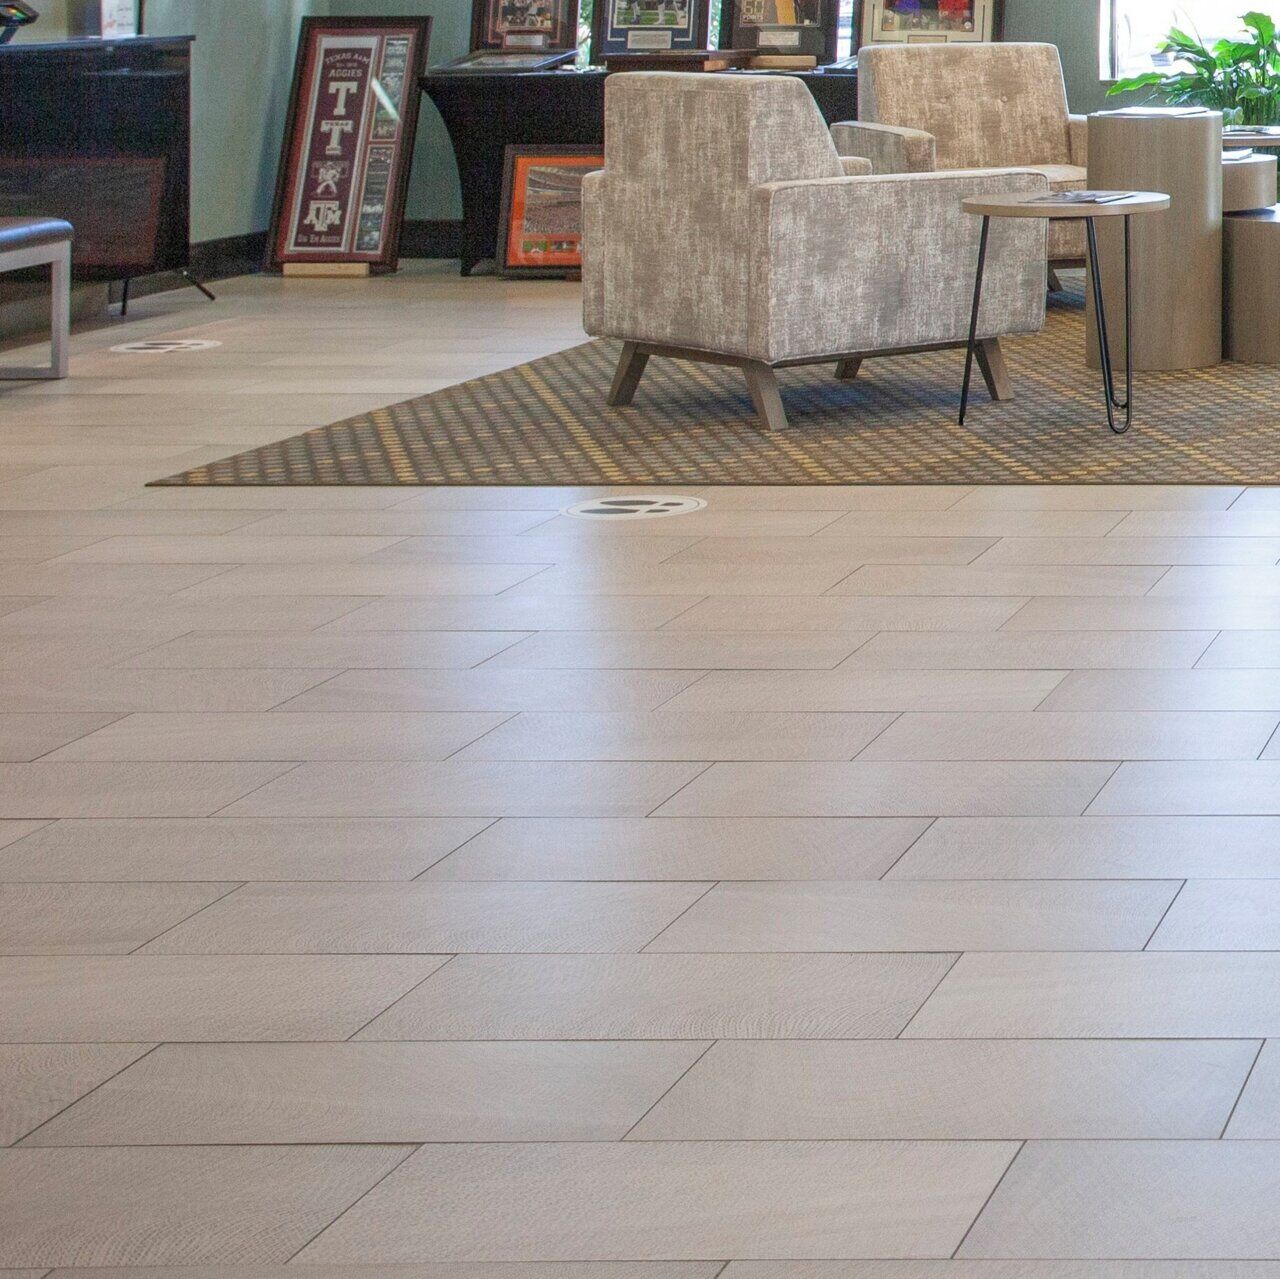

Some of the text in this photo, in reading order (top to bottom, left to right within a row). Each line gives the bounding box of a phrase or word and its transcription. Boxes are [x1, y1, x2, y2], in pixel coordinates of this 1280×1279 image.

[325, 52, 351, 65] TEXAS
[329, 69, 363, 77] AGGIES
[328, 81, 359, 116] T
